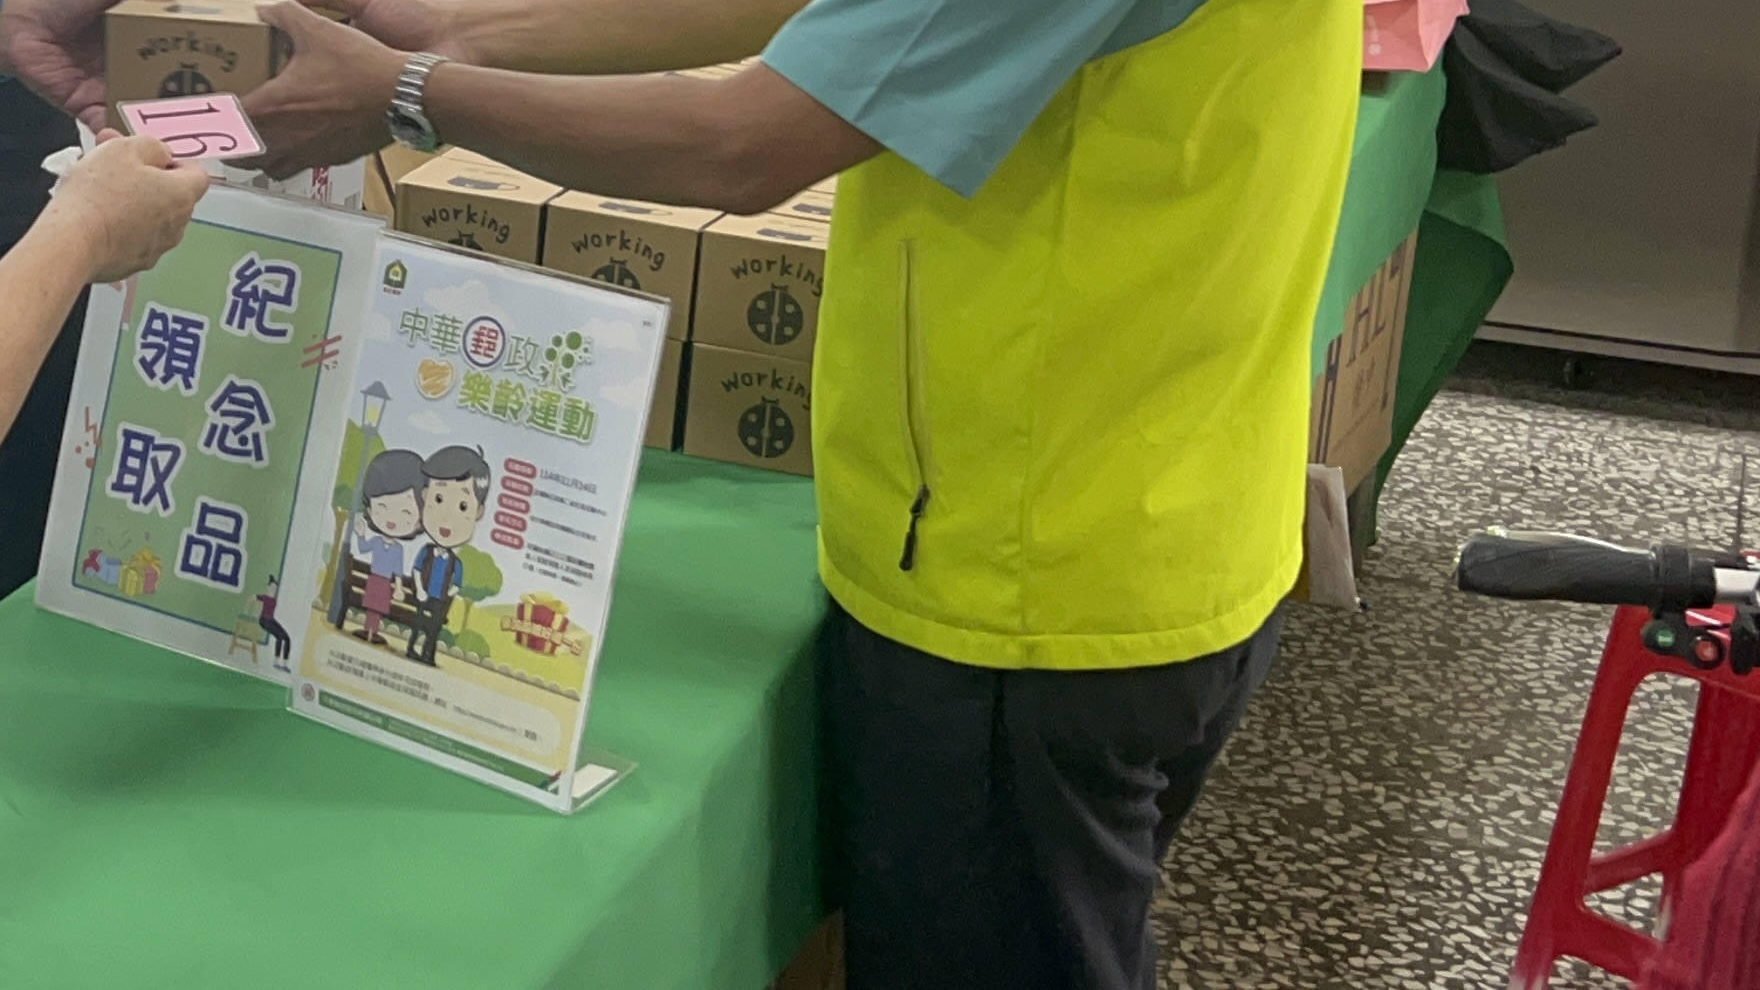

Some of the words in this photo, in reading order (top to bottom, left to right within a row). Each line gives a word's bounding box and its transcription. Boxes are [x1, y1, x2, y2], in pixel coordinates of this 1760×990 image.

[136, 30, 237, 73] working
[137, 102, 238, 157] 16
[421, 204, 511, 243] working
[571, 230, 665, 271] working
[399, 307, 539, 378] 中華郵政
[110, 309, 204, 512] 領取
[180, 258, 297, 587] 紀念品
[458, 372, 597, 443] 樂齡運動
